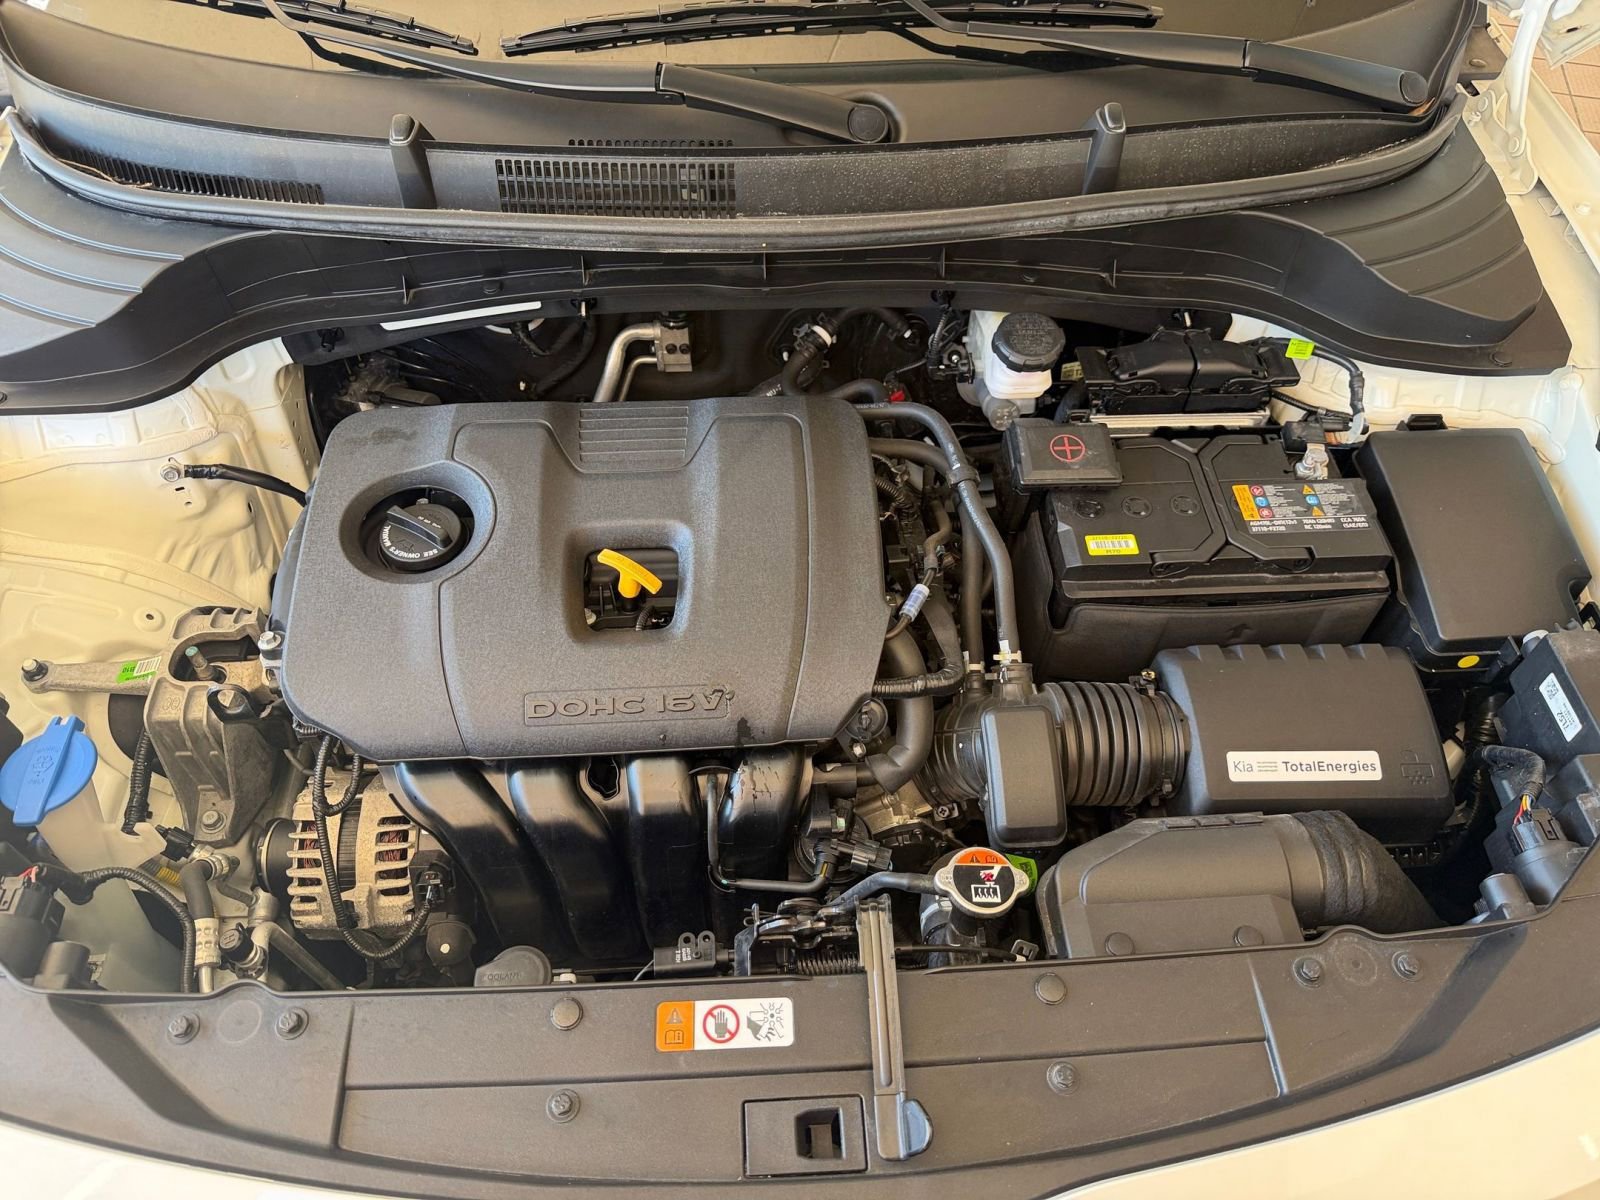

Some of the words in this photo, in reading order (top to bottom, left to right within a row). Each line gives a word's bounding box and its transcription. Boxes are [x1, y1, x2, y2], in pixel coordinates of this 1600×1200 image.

[388, 546, 421, 559] OWNER'S
[423, 548, 438, 558] SEE
[528, 697, 645, 719] DOHC
[656, 689, 725, 713] 16V
[1233, 760, 1254, 773] Kia
[1281, 760, 1377, 775] TotalEnergies
